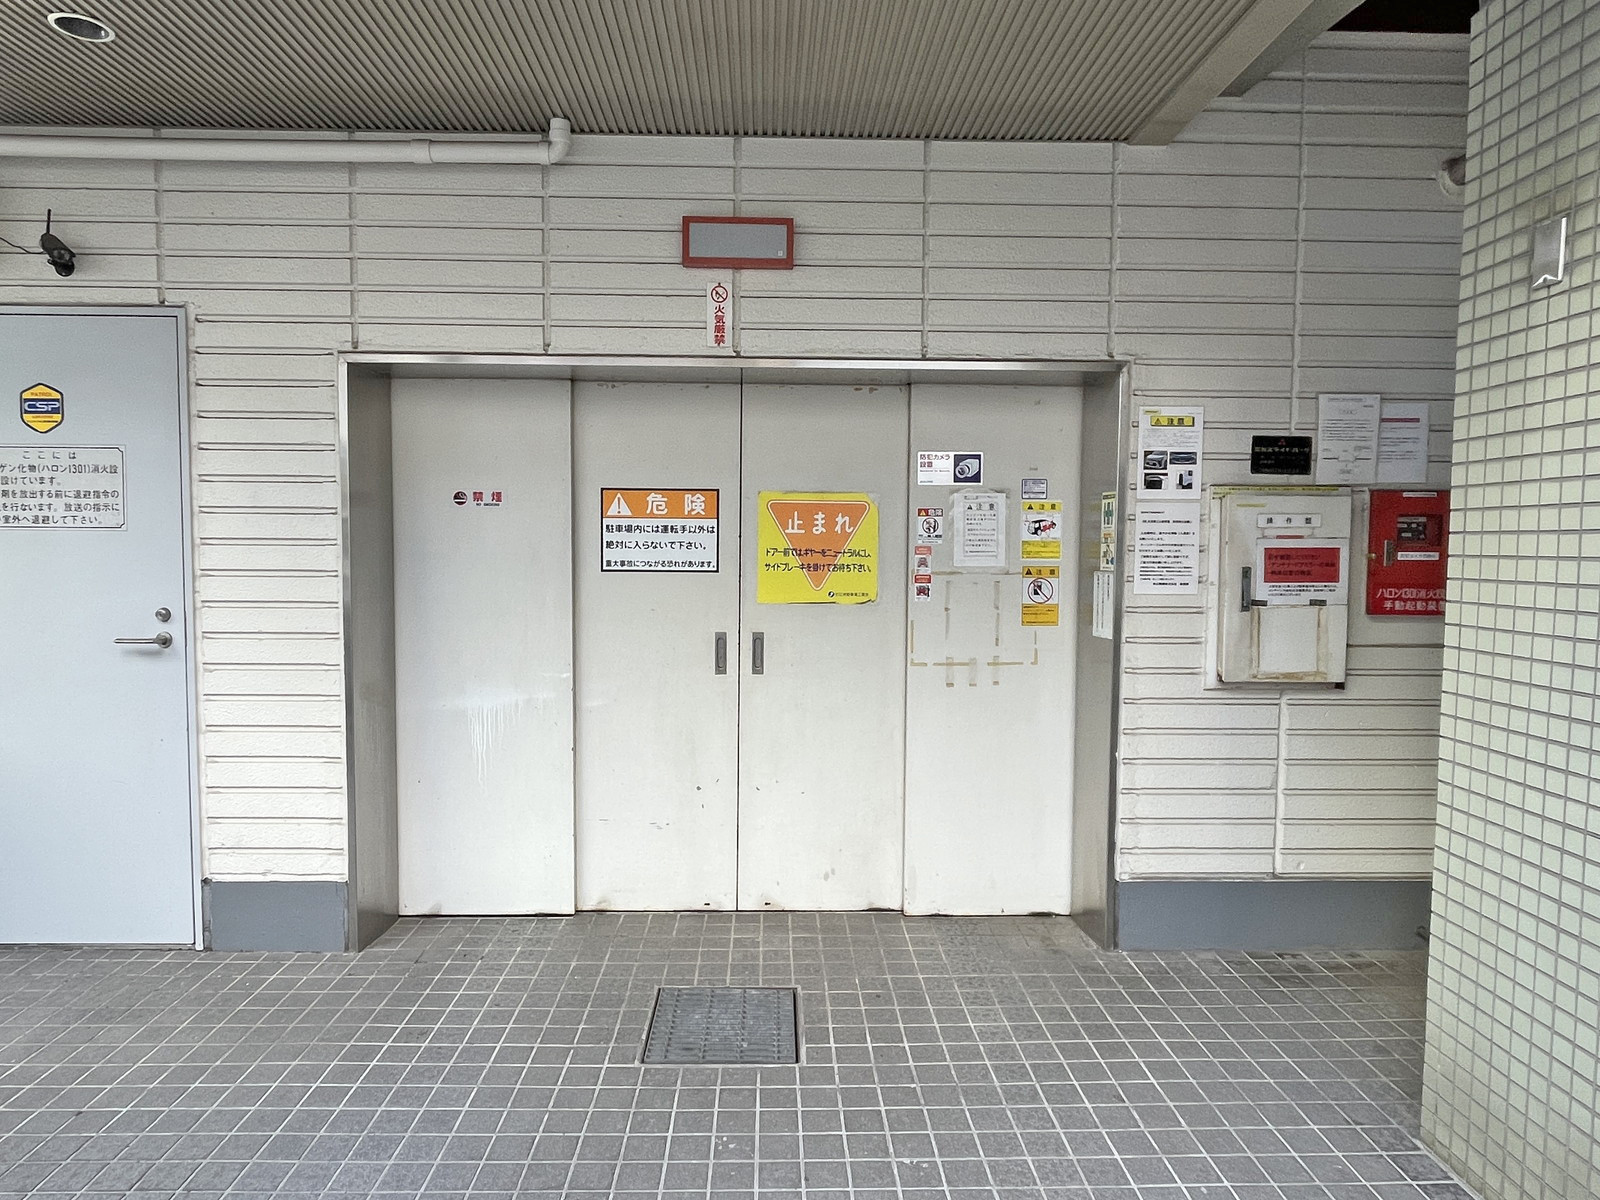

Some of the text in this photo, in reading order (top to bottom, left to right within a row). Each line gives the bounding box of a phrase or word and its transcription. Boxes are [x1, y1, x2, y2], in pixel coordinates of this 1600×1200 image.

[714, 304, 725, 346] 火気厳禁
[24, 401, 60, 411] CSP
[22, 450, 77, 460] ここには
[472, 491, 502, 502] 禁煙
[0, 502, 120, 513] を行ないます。放送の指示に
[645, 492, 706, 516] 危険
[0, 514, 103, 525] 室外へ退避して下さい。
[784, 510, 855, 535] 止まれ
[605, 524, 716, 534] 駐車場内には運転手以外は
[605, 540, 707, 551] 絶対に入らないで下さい。
[605, 559, 716, 569] 重大事故につながる恐れがあります。
